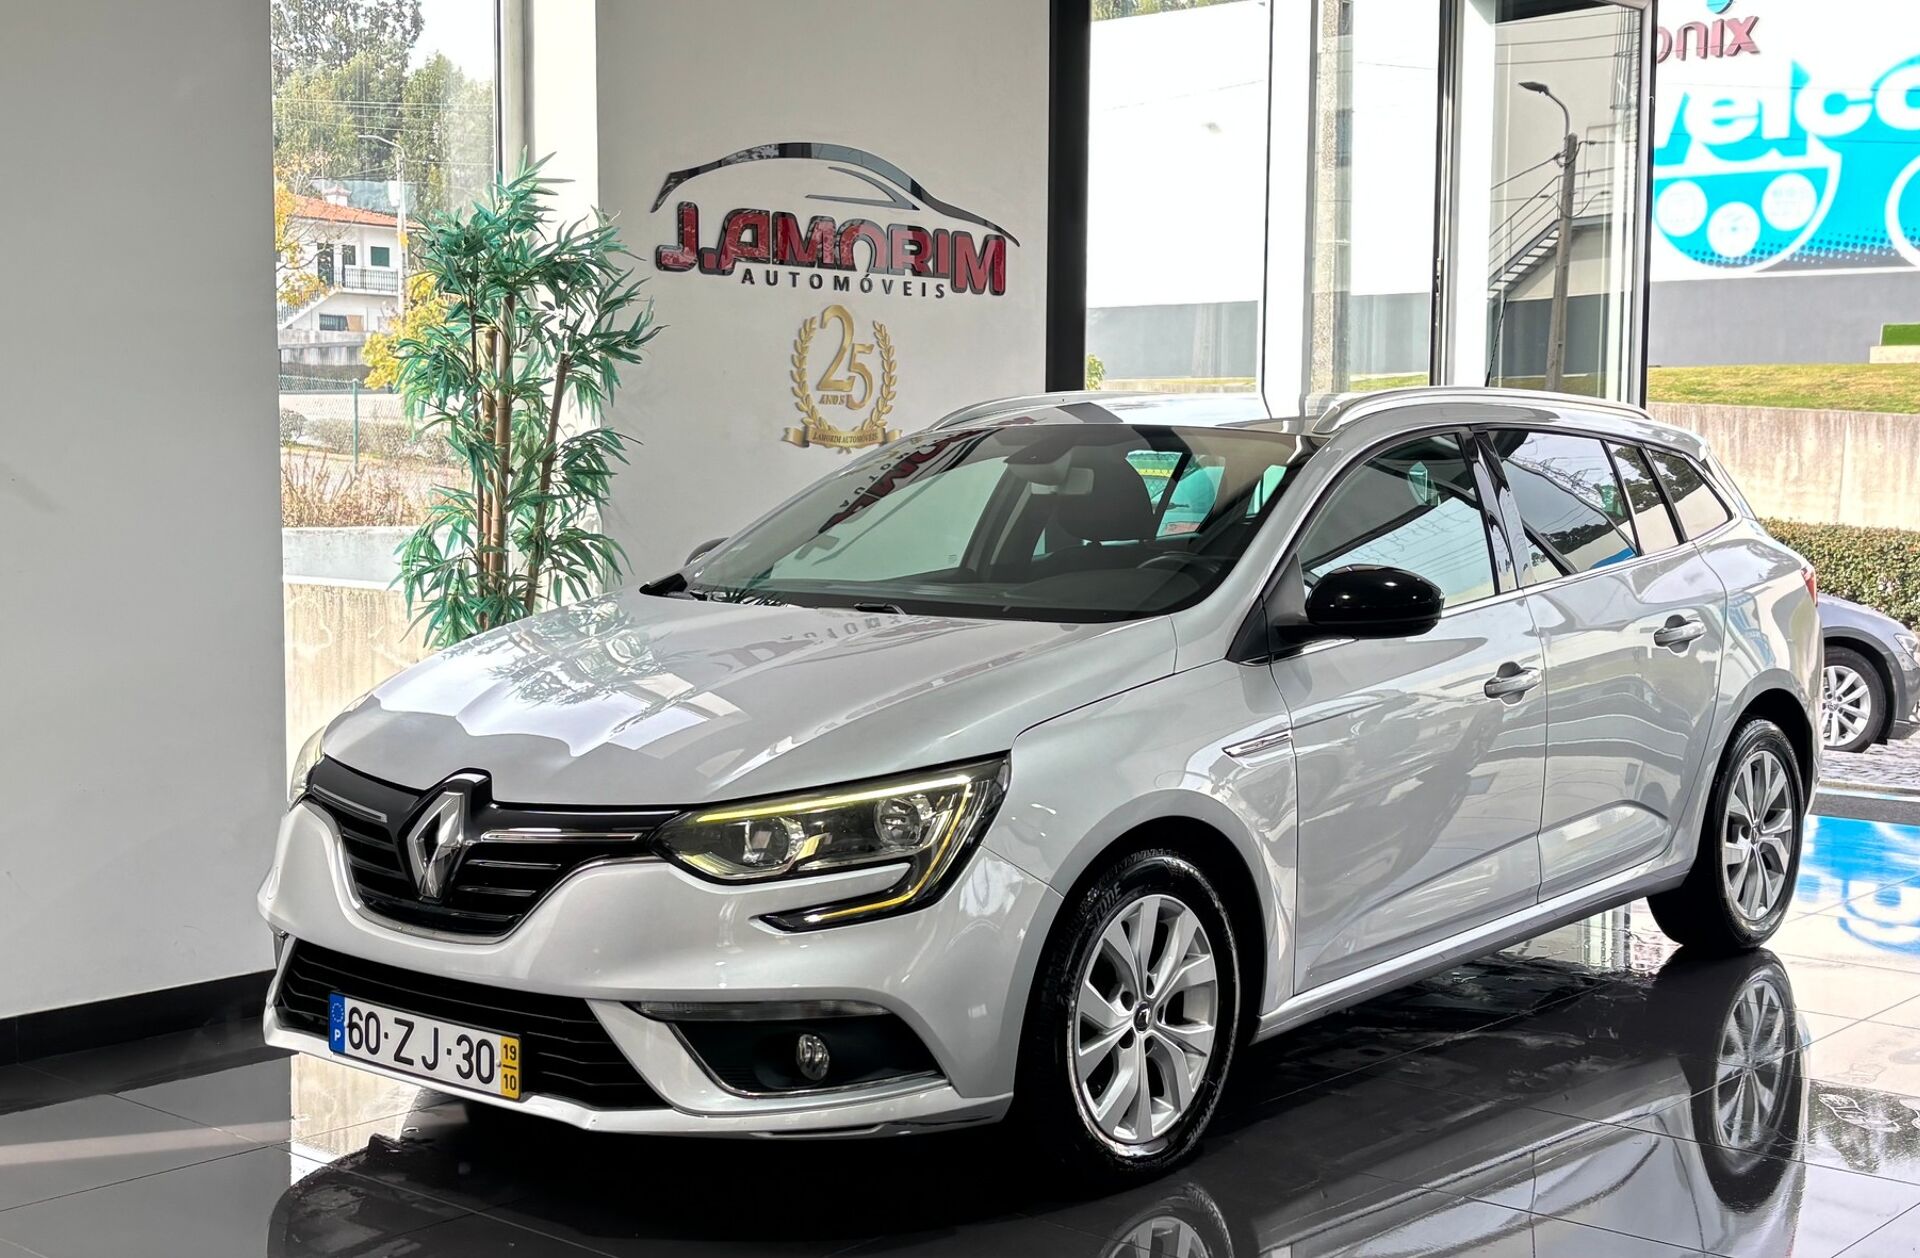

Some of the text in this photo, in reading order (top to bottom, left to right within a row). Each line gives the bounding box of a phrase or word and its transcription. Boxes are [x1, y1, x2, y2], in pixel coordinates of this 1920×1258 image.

[741, 269, 945, 298] AUTOMÓVEIS
[816, 304, 875, 410] 25
[819, 394, 846, 405] ANOS
[334, 1028, 342, 1042] P
[503, 1043, 517, 1061] 19
[503, 1074, 517, 1091] 10
